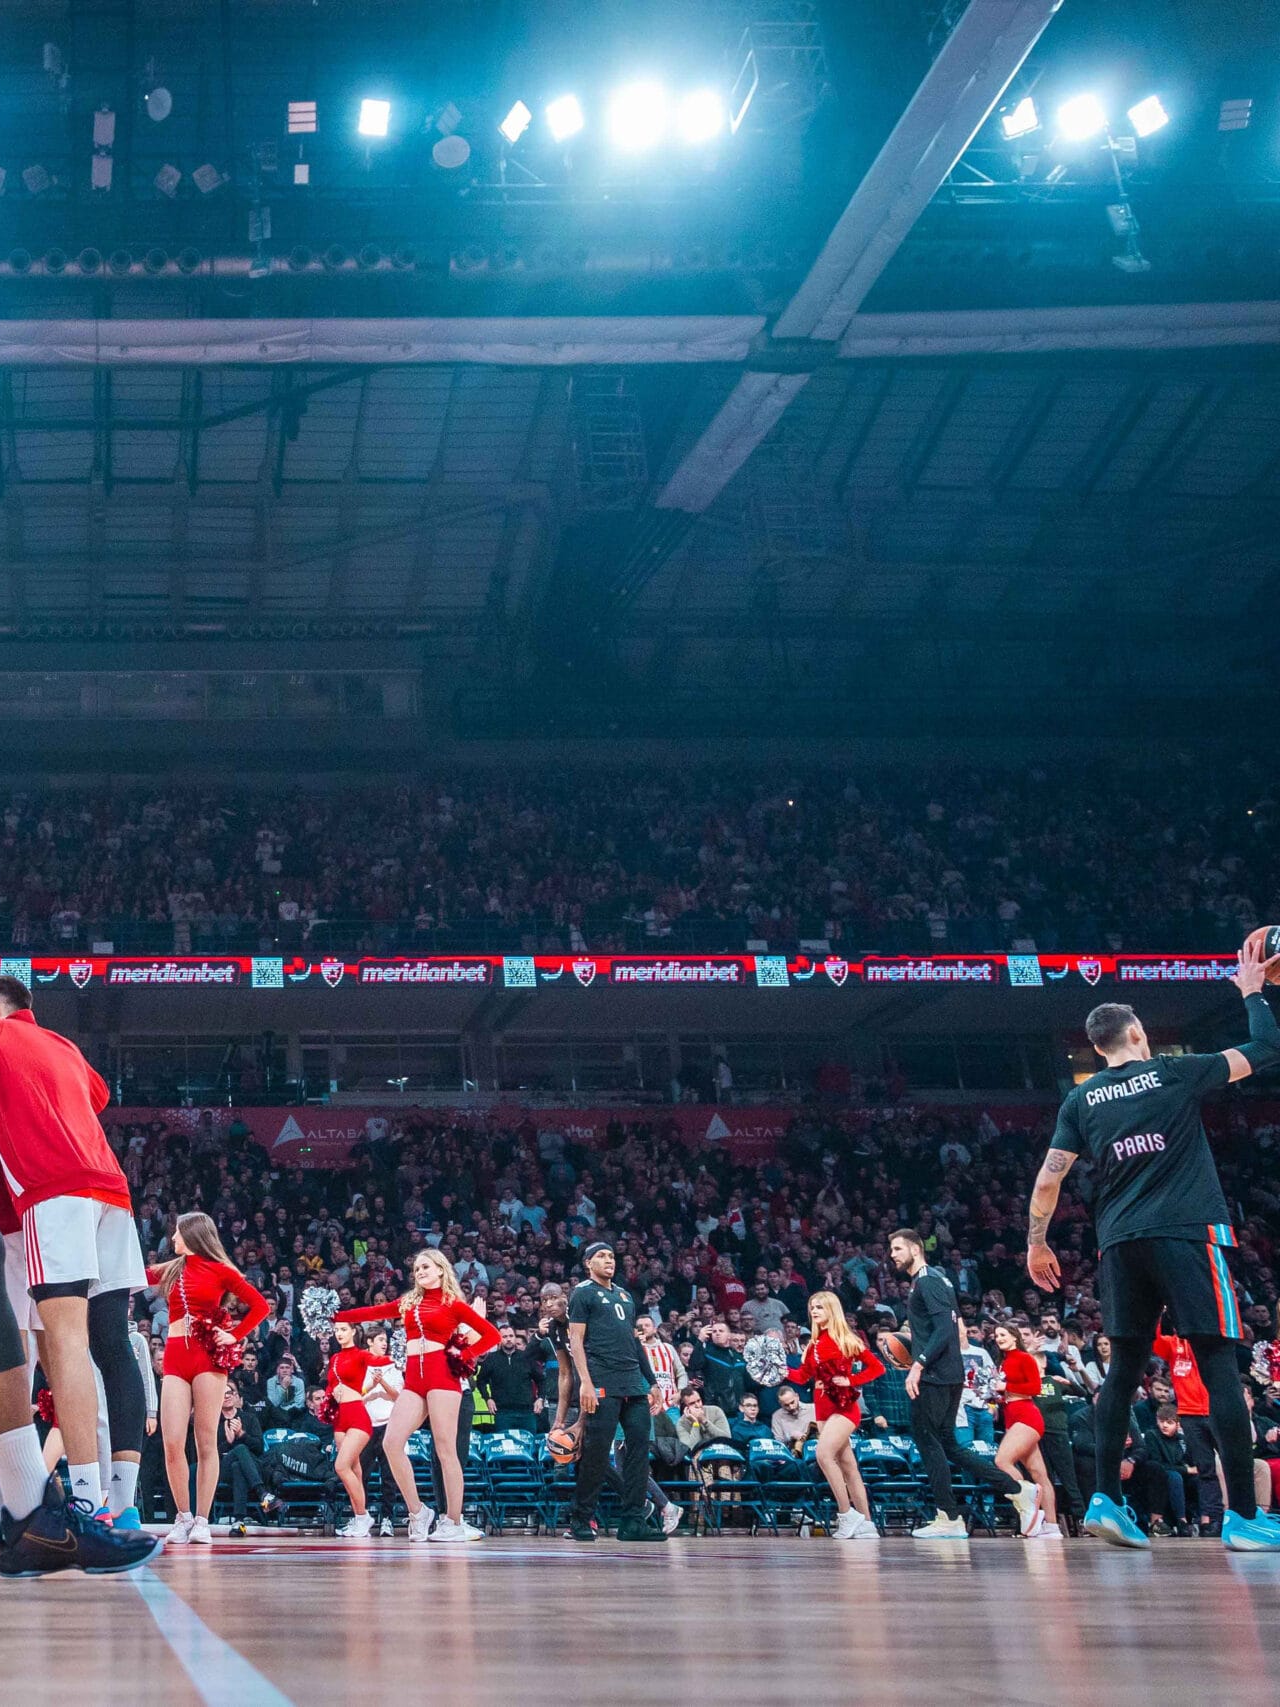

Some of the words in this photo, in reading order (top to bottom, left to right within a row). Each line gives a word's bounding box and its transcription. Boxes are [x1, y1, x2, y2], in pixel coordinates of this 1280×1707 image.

[110, 963, 235, 982] meridianbet
[361, 962, 486, 982] meridianbet
[614, 961, 738, 981] meridianbet
[867, 961, 991, 981] meridianbet
[1086, 1071, 1163, 1106] CAVALIERE
[1113, 1133, 1166, 1161] PARIS
[614, 1303, 626, 1321] 0
